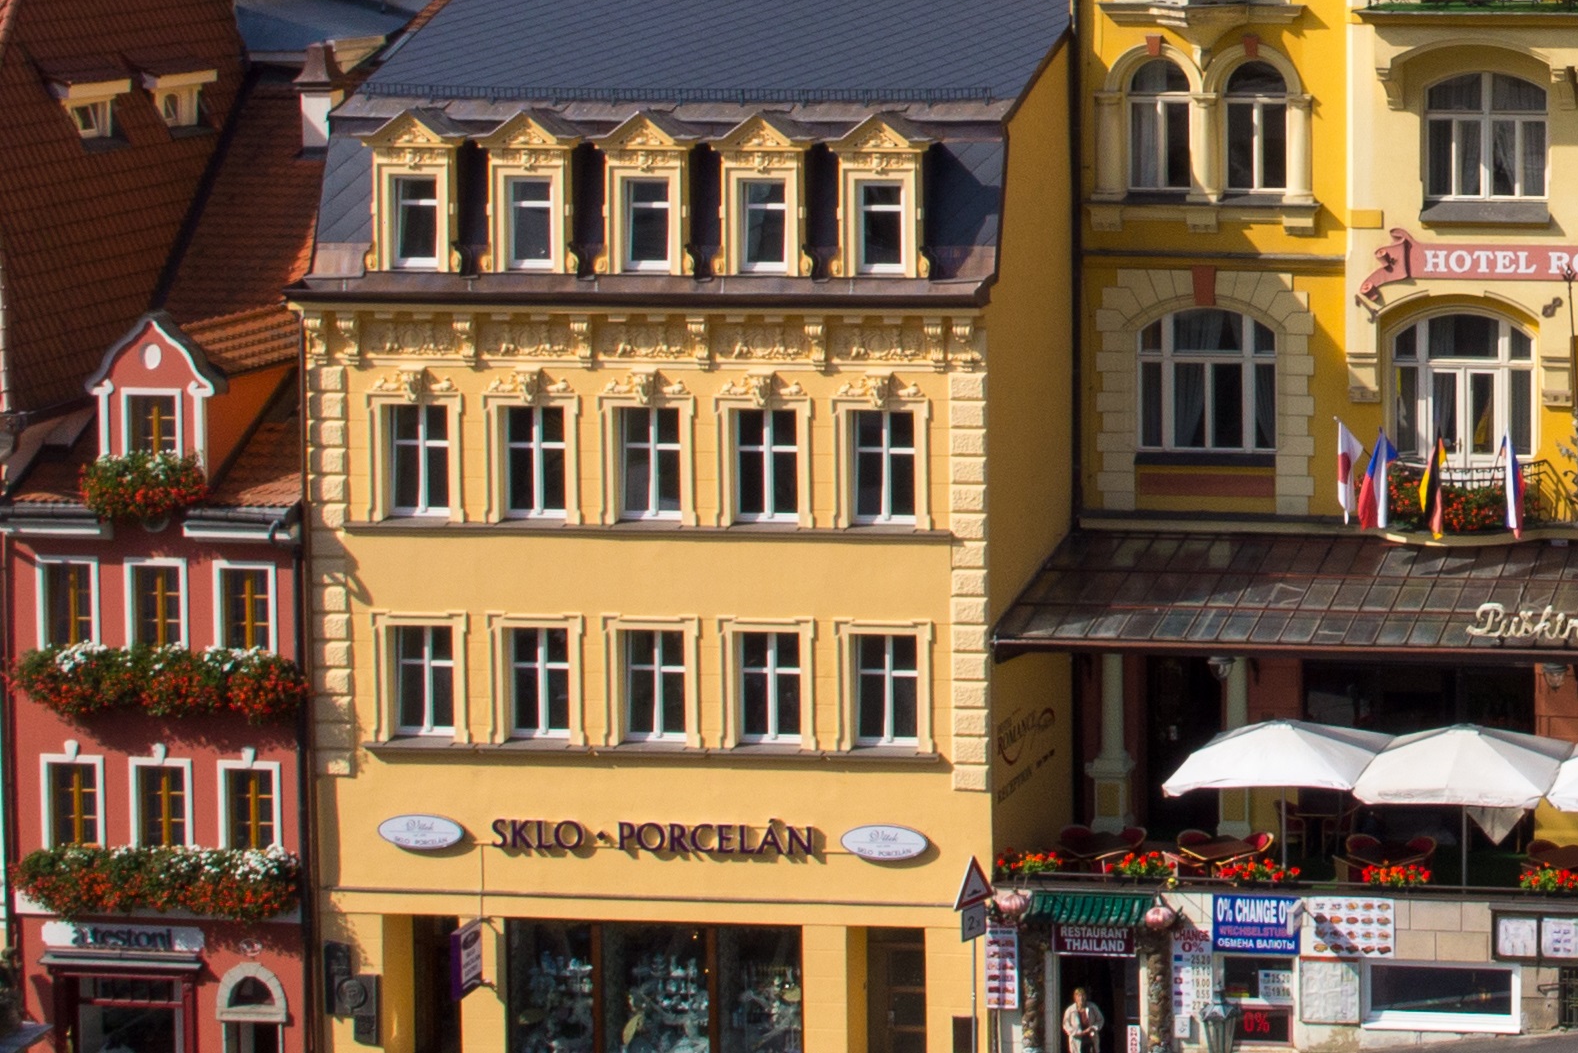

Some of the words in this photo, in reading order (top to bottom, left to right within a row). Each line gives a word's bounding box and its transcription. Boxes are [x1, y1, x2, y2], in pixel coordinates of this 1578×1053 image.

[1424, 250, 1537, 274] HOTEL
[490, 818, 584, 849] SKLO
[618, 817, 814, 856] PORCELÁN
[1217, 897, 1234, 923] 0%
[1235, 898, 1278, 924] CHANGE
[1060, 926, 1129, 939] RESTAURANT
[1174, 930, 1210, 941] CHANGE
[1064, 938, 1126, 952] THAILAND
[1217, 937, 1255, 949] ОБМЕНА
[1255, 939, 1296, 950] ВАЛЮТЫ
[1243, 1011, 1270, 1033] 0%
